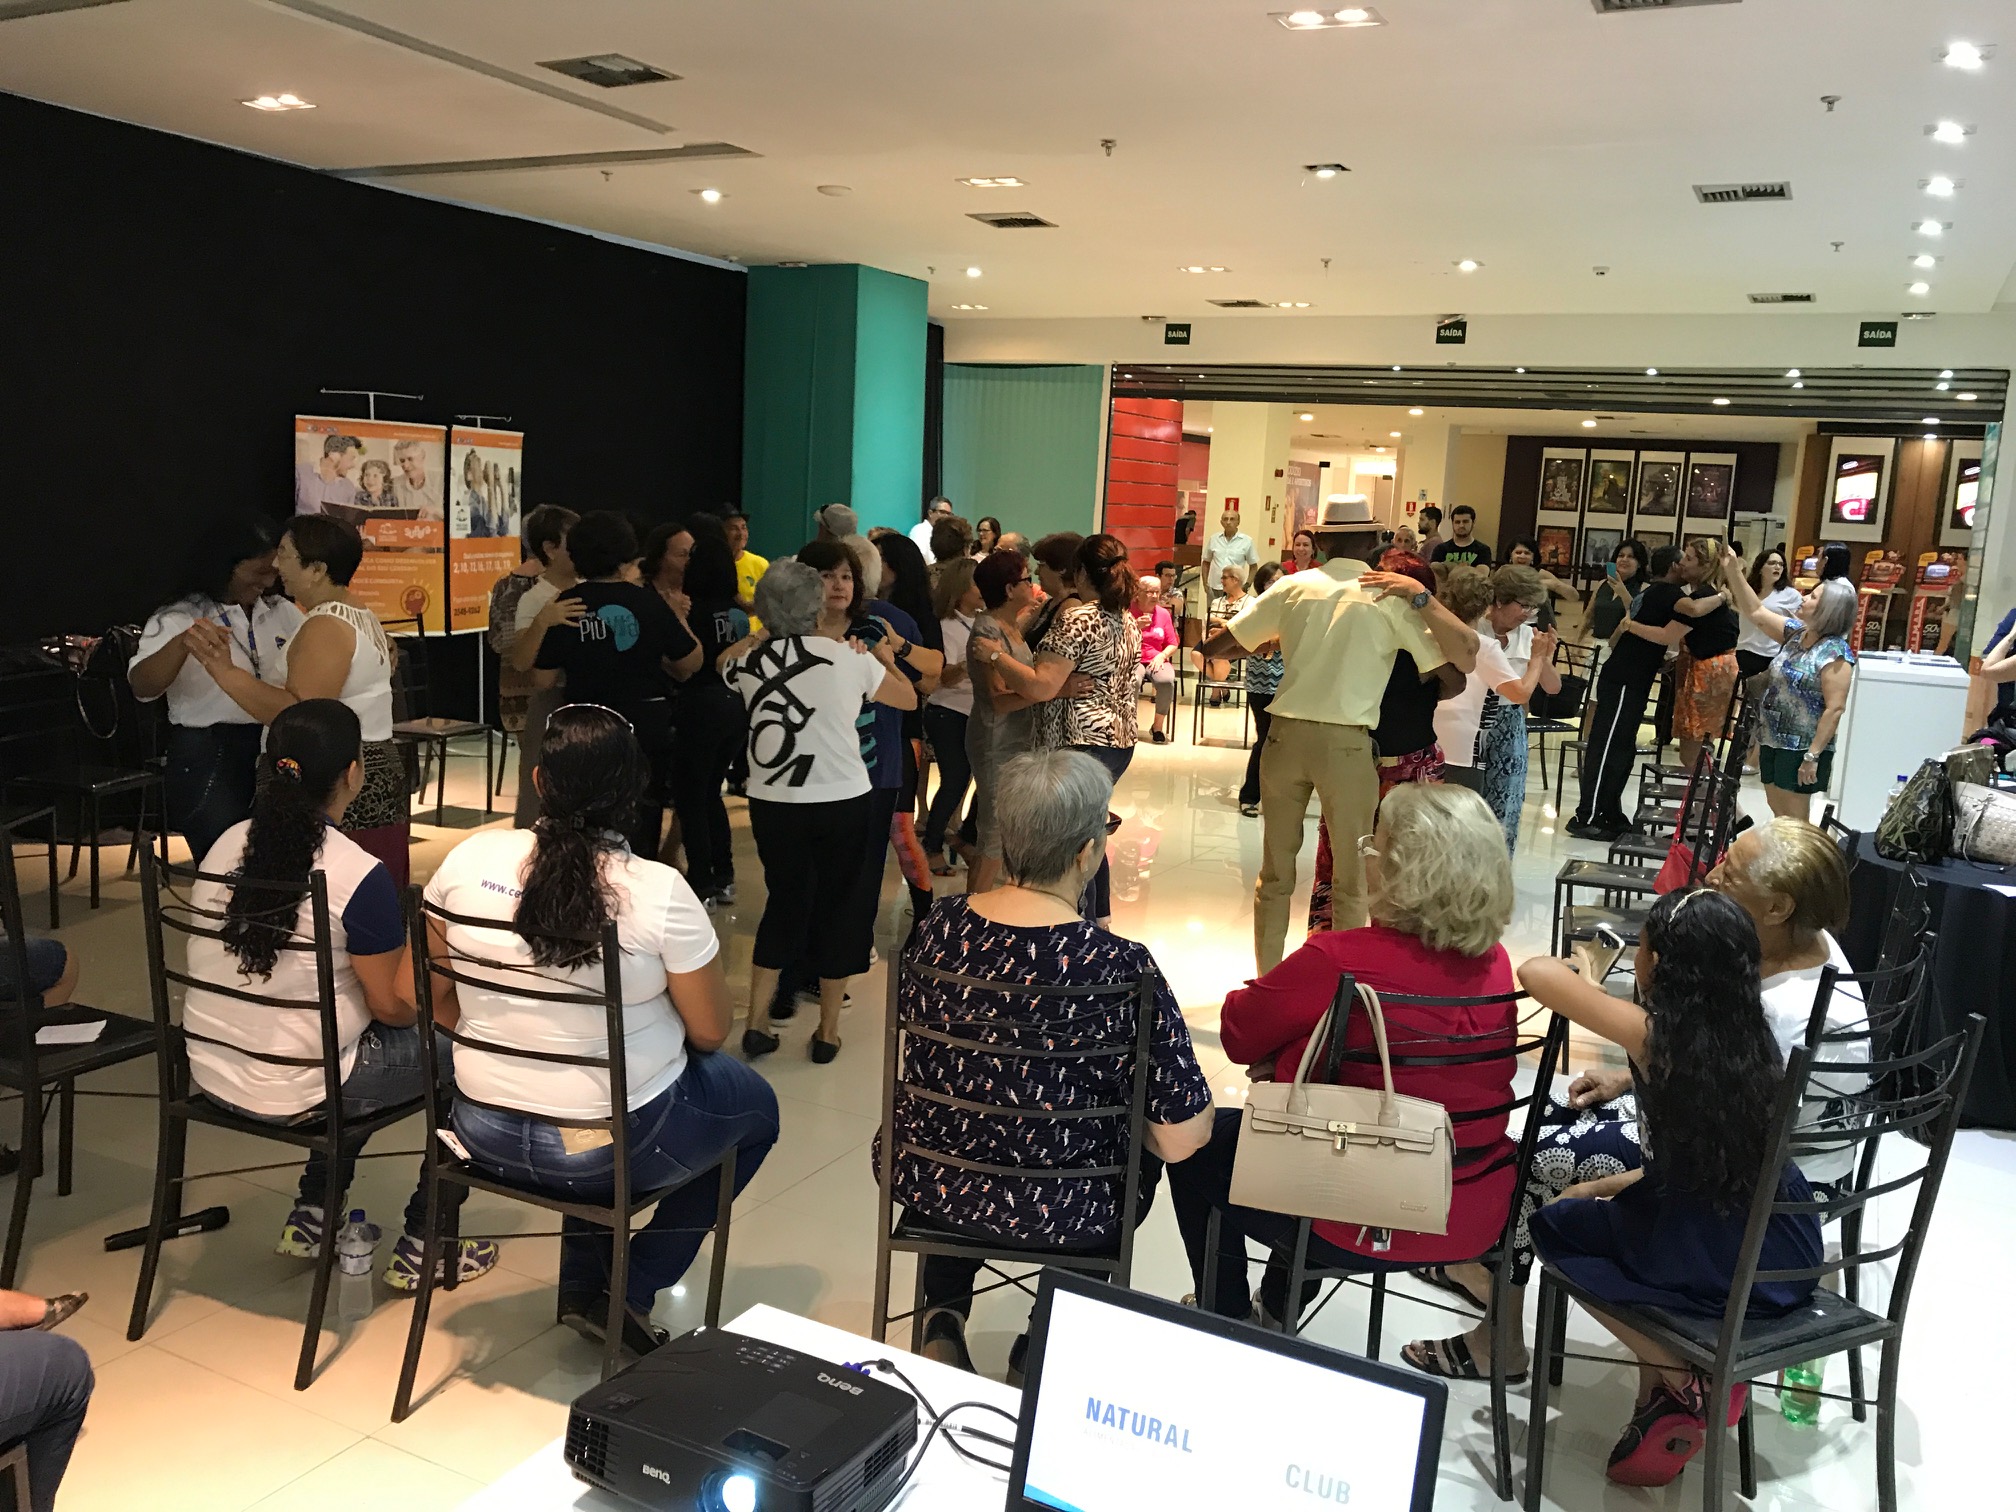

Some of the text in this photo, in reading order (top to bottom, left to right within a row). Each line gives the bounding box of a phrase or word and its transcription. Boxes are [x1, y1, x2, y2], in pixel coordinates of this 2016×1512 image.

[1168, 330, 1188, 338] SAÍDA
[1440, 328, 1463, 337] SAÍDA
[1864, 328, 1892, 339] SAÍDA
[1852, 595, 1869, 653] INEMARK
[1910, 597, 1926, 653] NEMARK
[480, 878, 522, 898] www.ce
[816, 1372, 864, 1396] BenQ
[1085, 1396, 1193, 1454] NATURAL
[642, 1464, 671, 1484] BenQ
[1285, 1463, 1351, 1505] CLUB
